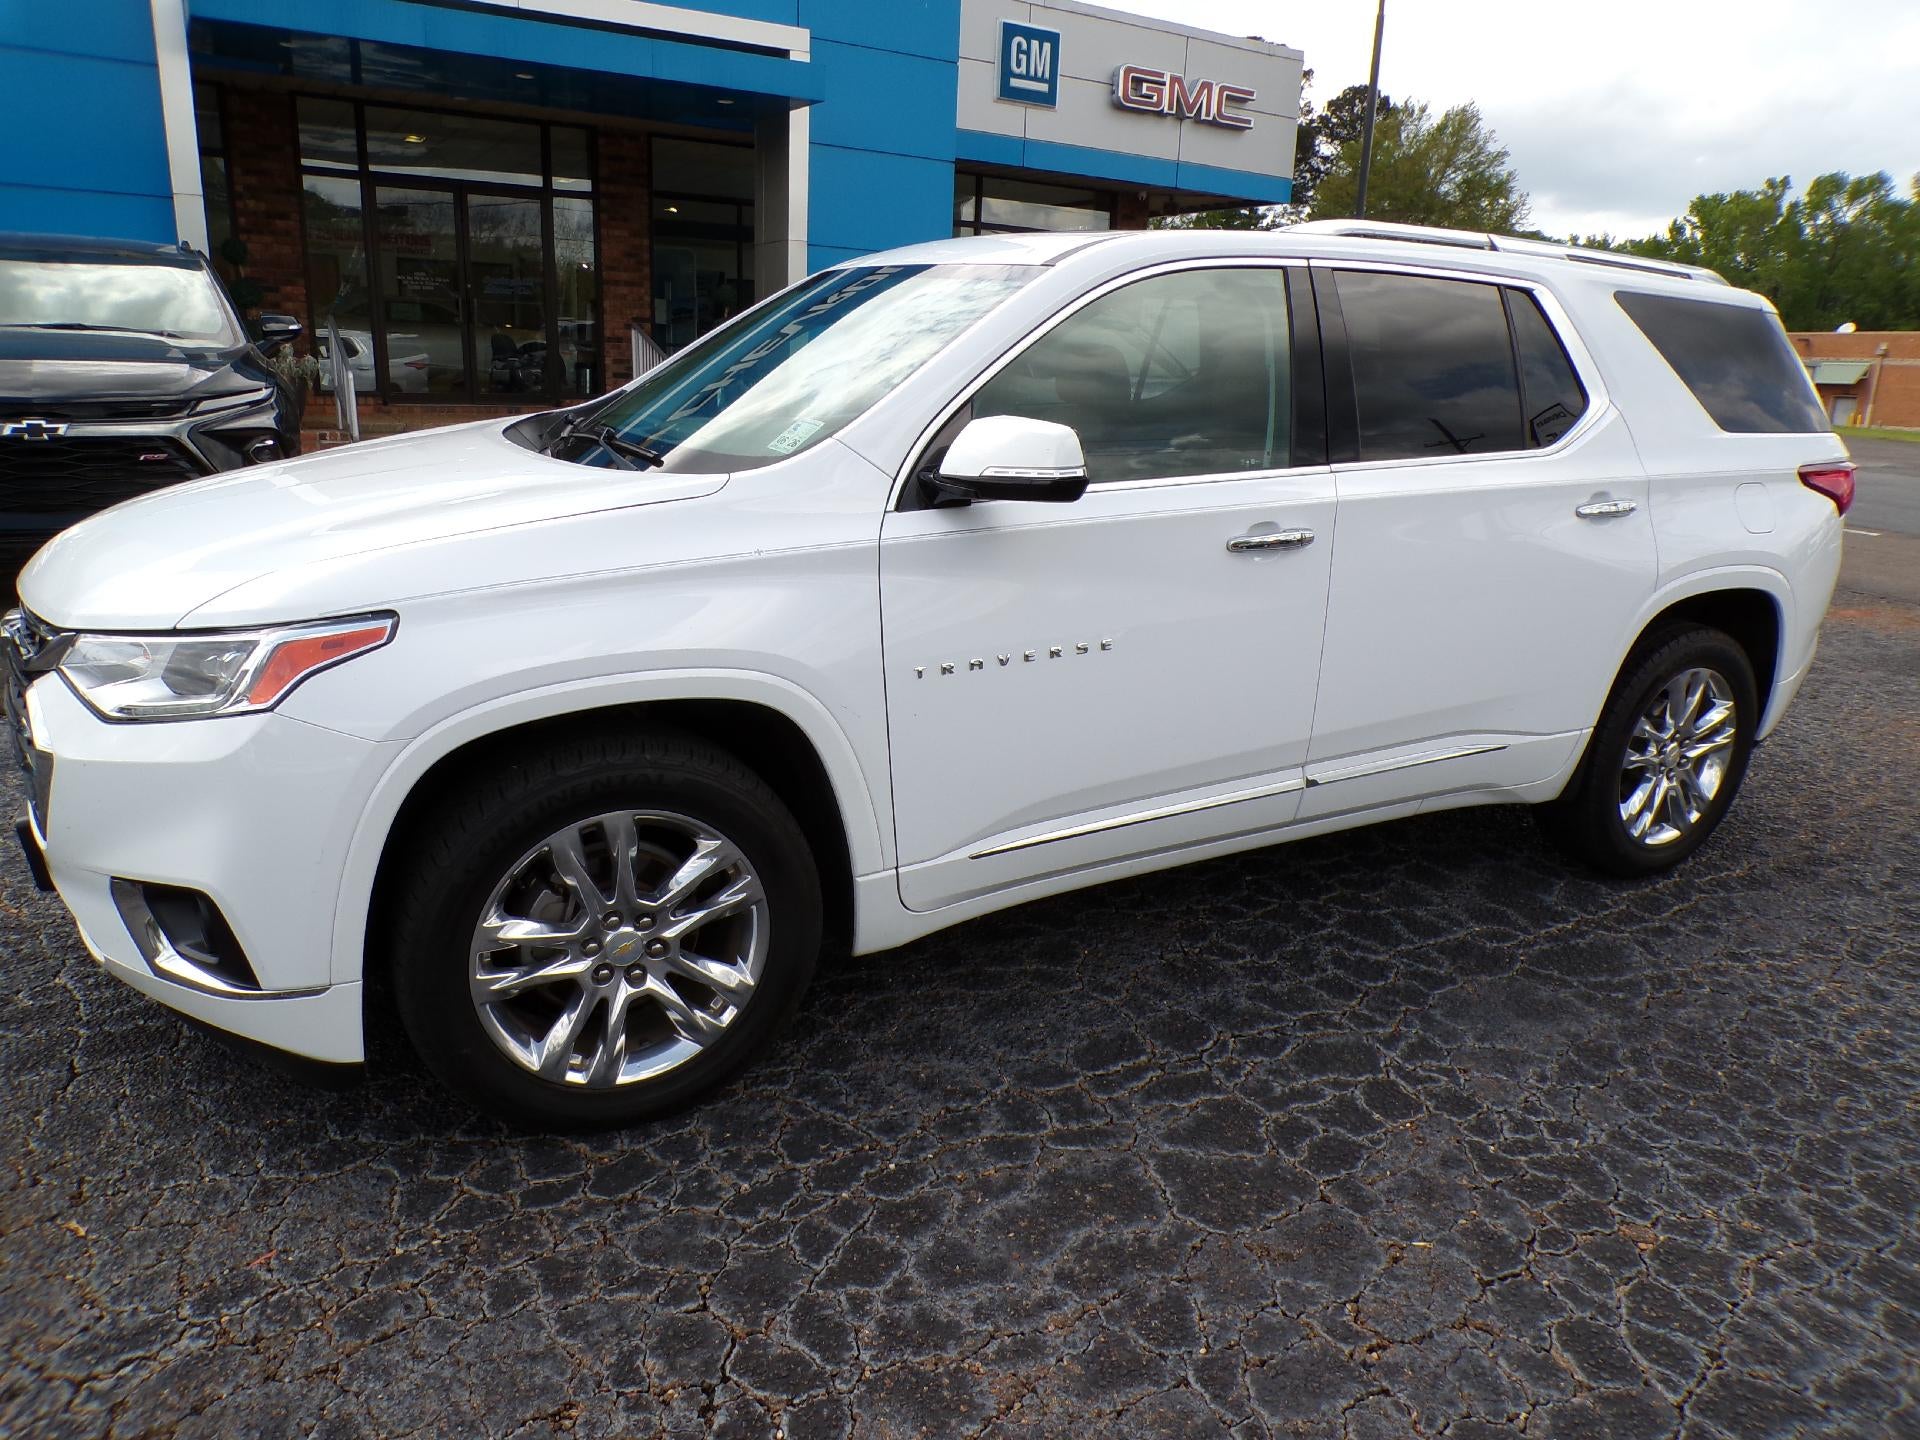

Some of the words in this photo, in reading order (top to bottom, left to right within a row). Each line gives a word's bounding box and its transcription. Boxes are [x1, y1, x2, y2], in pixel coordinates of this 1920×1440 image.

[1010, 35, 1051, 81] GM
[1116, 64, 1257, 130] GMC
[913, 638, 1113, 679] TRAVERSE
